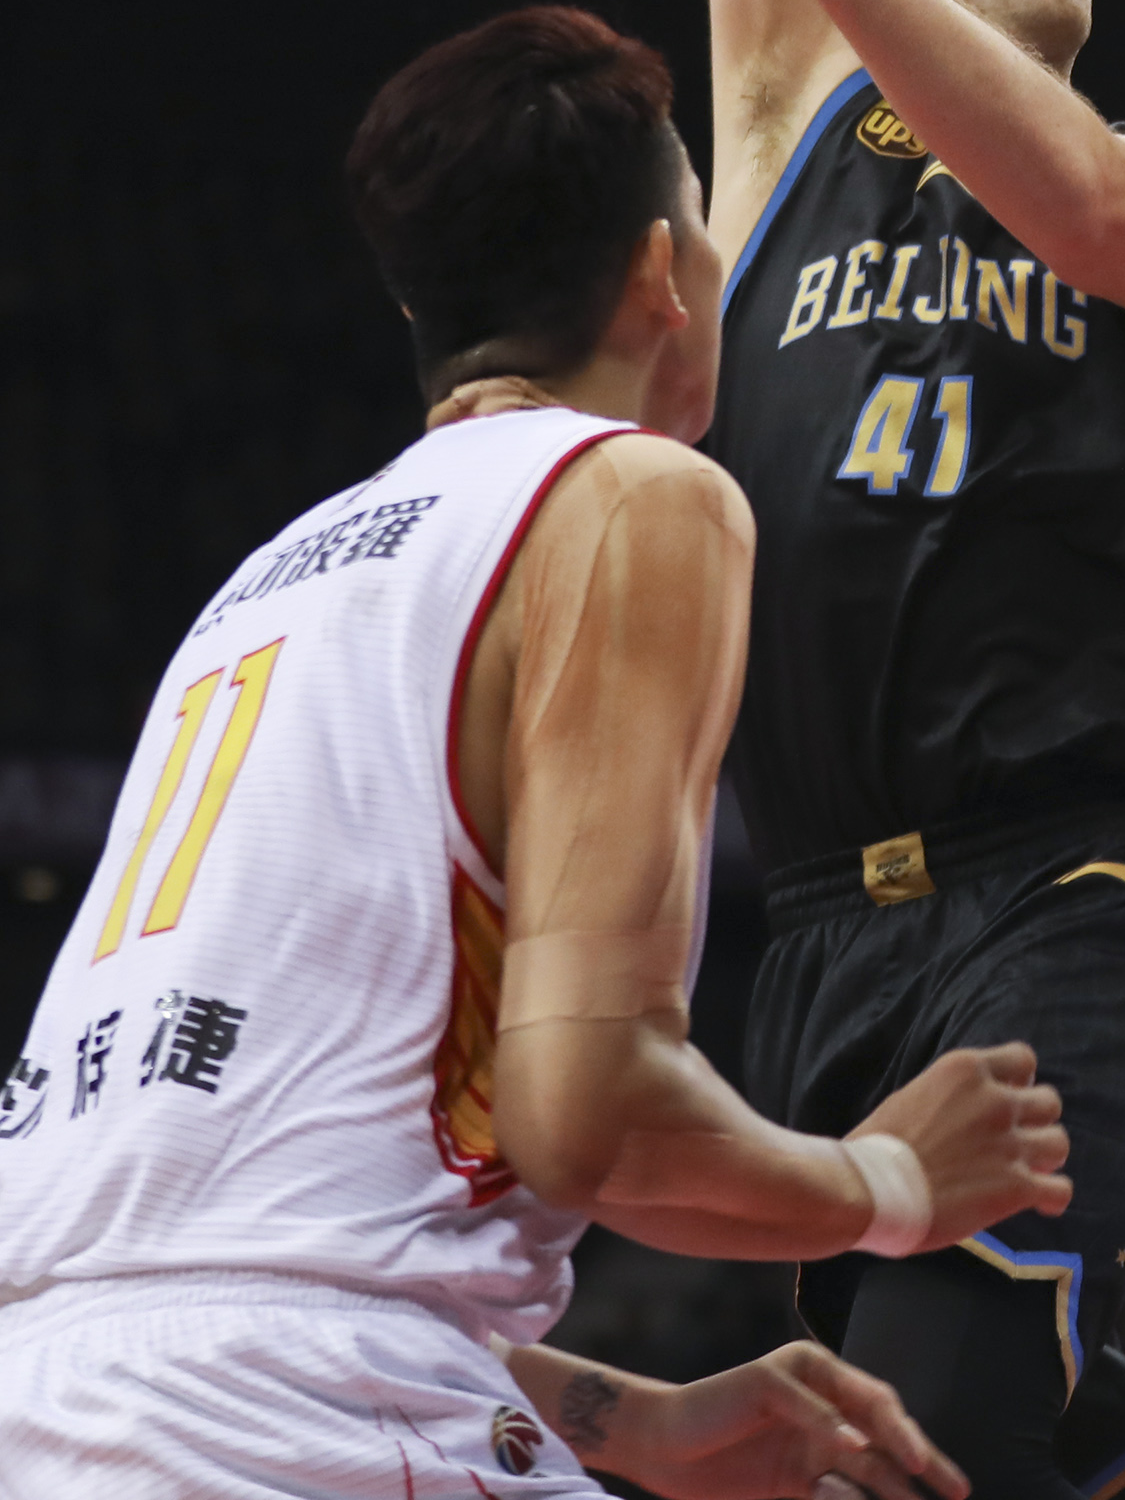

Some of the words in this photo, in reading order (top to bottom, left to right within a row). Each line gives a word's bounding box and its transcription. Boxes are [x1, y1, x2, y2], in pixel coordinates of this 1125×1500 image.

[778, 235, 1088, 362] BEIJING
[836, 372, 974, 497] 41
[92, 636, 287, 967] 11
